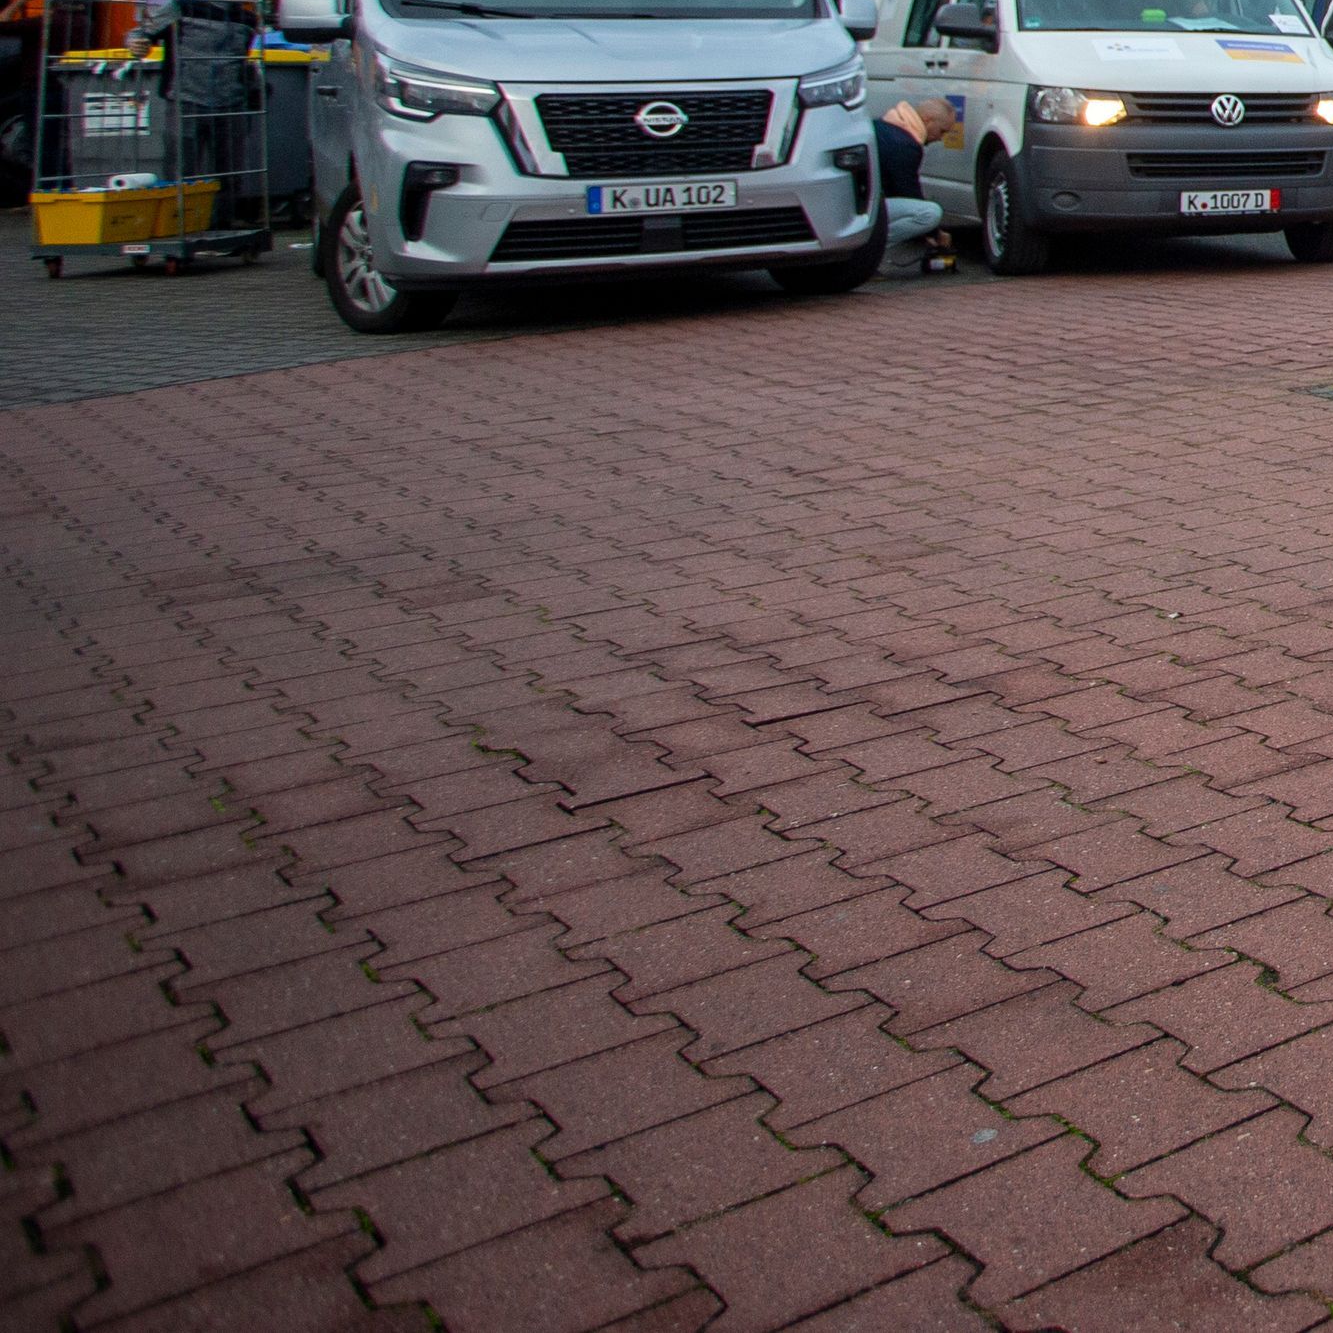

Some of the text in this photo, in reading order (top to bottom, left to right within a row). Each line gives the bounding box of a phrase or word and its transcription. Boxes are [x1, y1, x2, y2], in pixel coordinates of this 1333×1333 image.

[612, 185, 725, 209] K UA 102
[1187, 193, 1264, 210] K 1007 D
